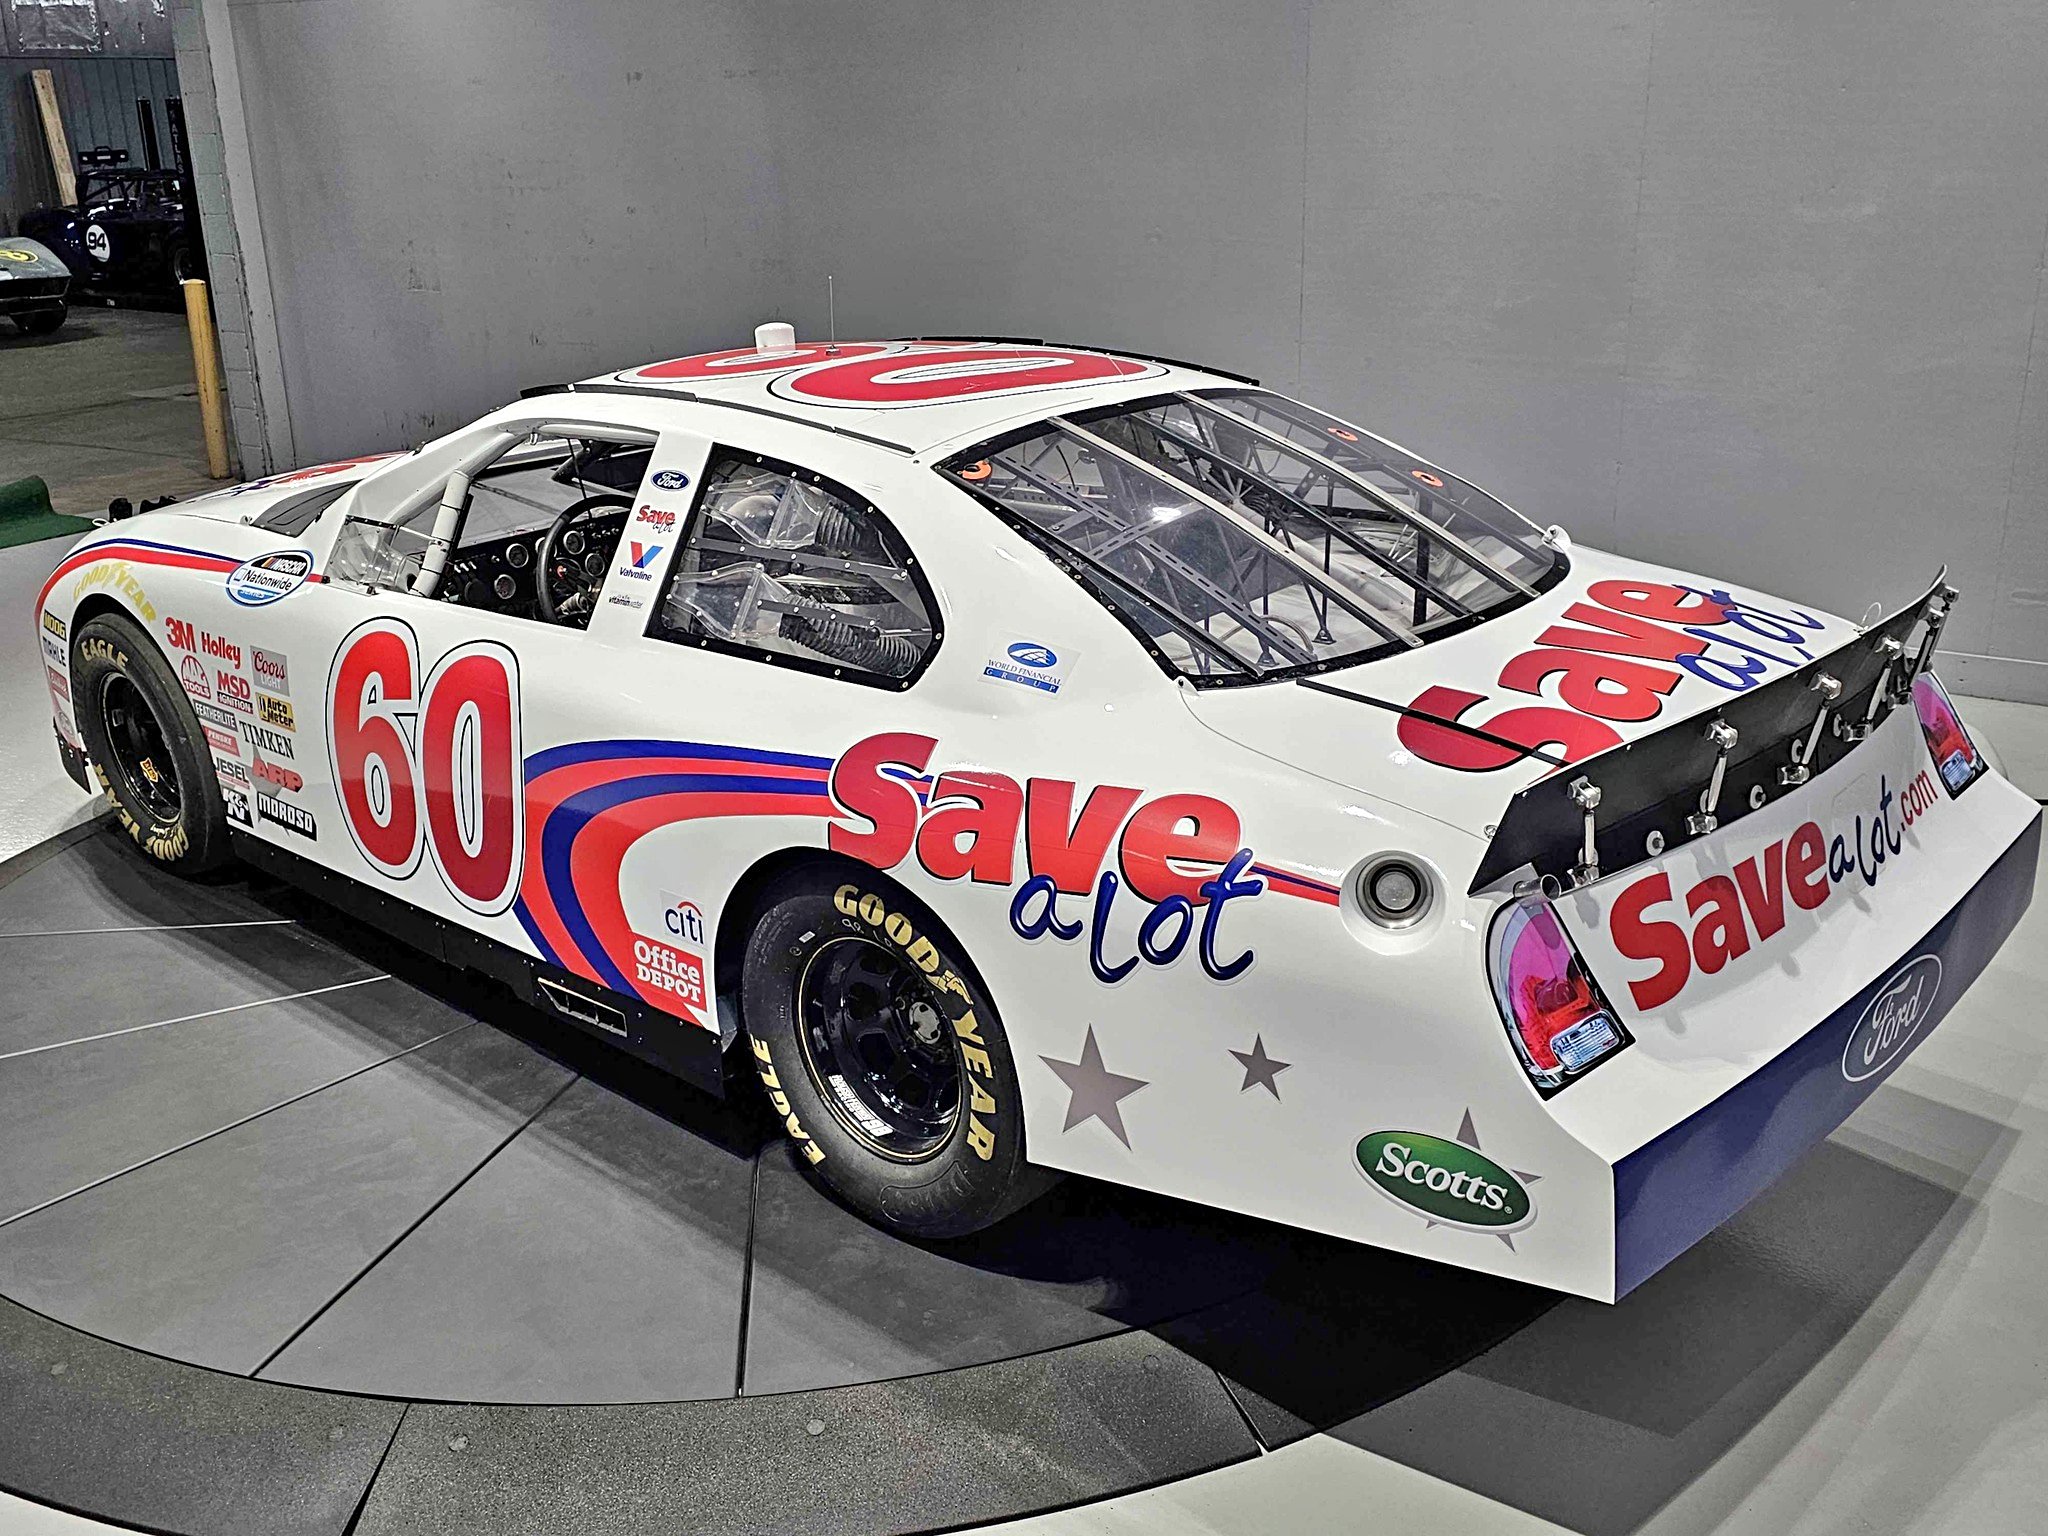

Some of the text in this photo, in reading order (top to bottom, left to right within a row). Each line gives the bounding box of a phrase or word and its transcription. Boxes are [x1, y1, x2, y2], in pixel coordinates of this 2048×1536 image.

[87, 231, 107, 251] 94
[656, 472, 685, 489] Ford
[636, 505, 676, 526] Save
[243, 569, 293, 591] Nationwide
[271, 558, 307, 575] NASCAR
[619, 566, 653, 582] Valvoline
[165, 616, 197, 654] 3M
[201, 631, 241, 670] Holley
[81, 638, 129, 672] EAGLE
[252, 650, 286, 680] Coors
[988, 659, 1018, 673] WORLD
[183, 680, 210, 698] TOOLS
[217, 670, 250, 700] MSD
[985, 667, 1056, 692] GROUP
[1018, 667, 1062, 686] FINANCIAL
[1396, 579, 1738, 786] Save
[266, 710, 294, 728] Meter
[267, 697, 288, 715] Auto
[239, 720, 295, 760] TIMKEN
[215, 757, 250, 784] JESEL
[252, 757, 304, 793] ARP
[329, 622, 520, 911] 60
[259, 792, 314, 833] MOROSO
[828, 731, 1241, 908] Save
[664, 903, 705, 945] citi
[633, 940, 701, 985] Office
[635, 962, 702, 1003] DEPOT
[1863, 970, 1926, 1066] Ford
[749, 1033, 827, 1165] EAGLE
[1375, 1142, 1508, 1211] Scotts
